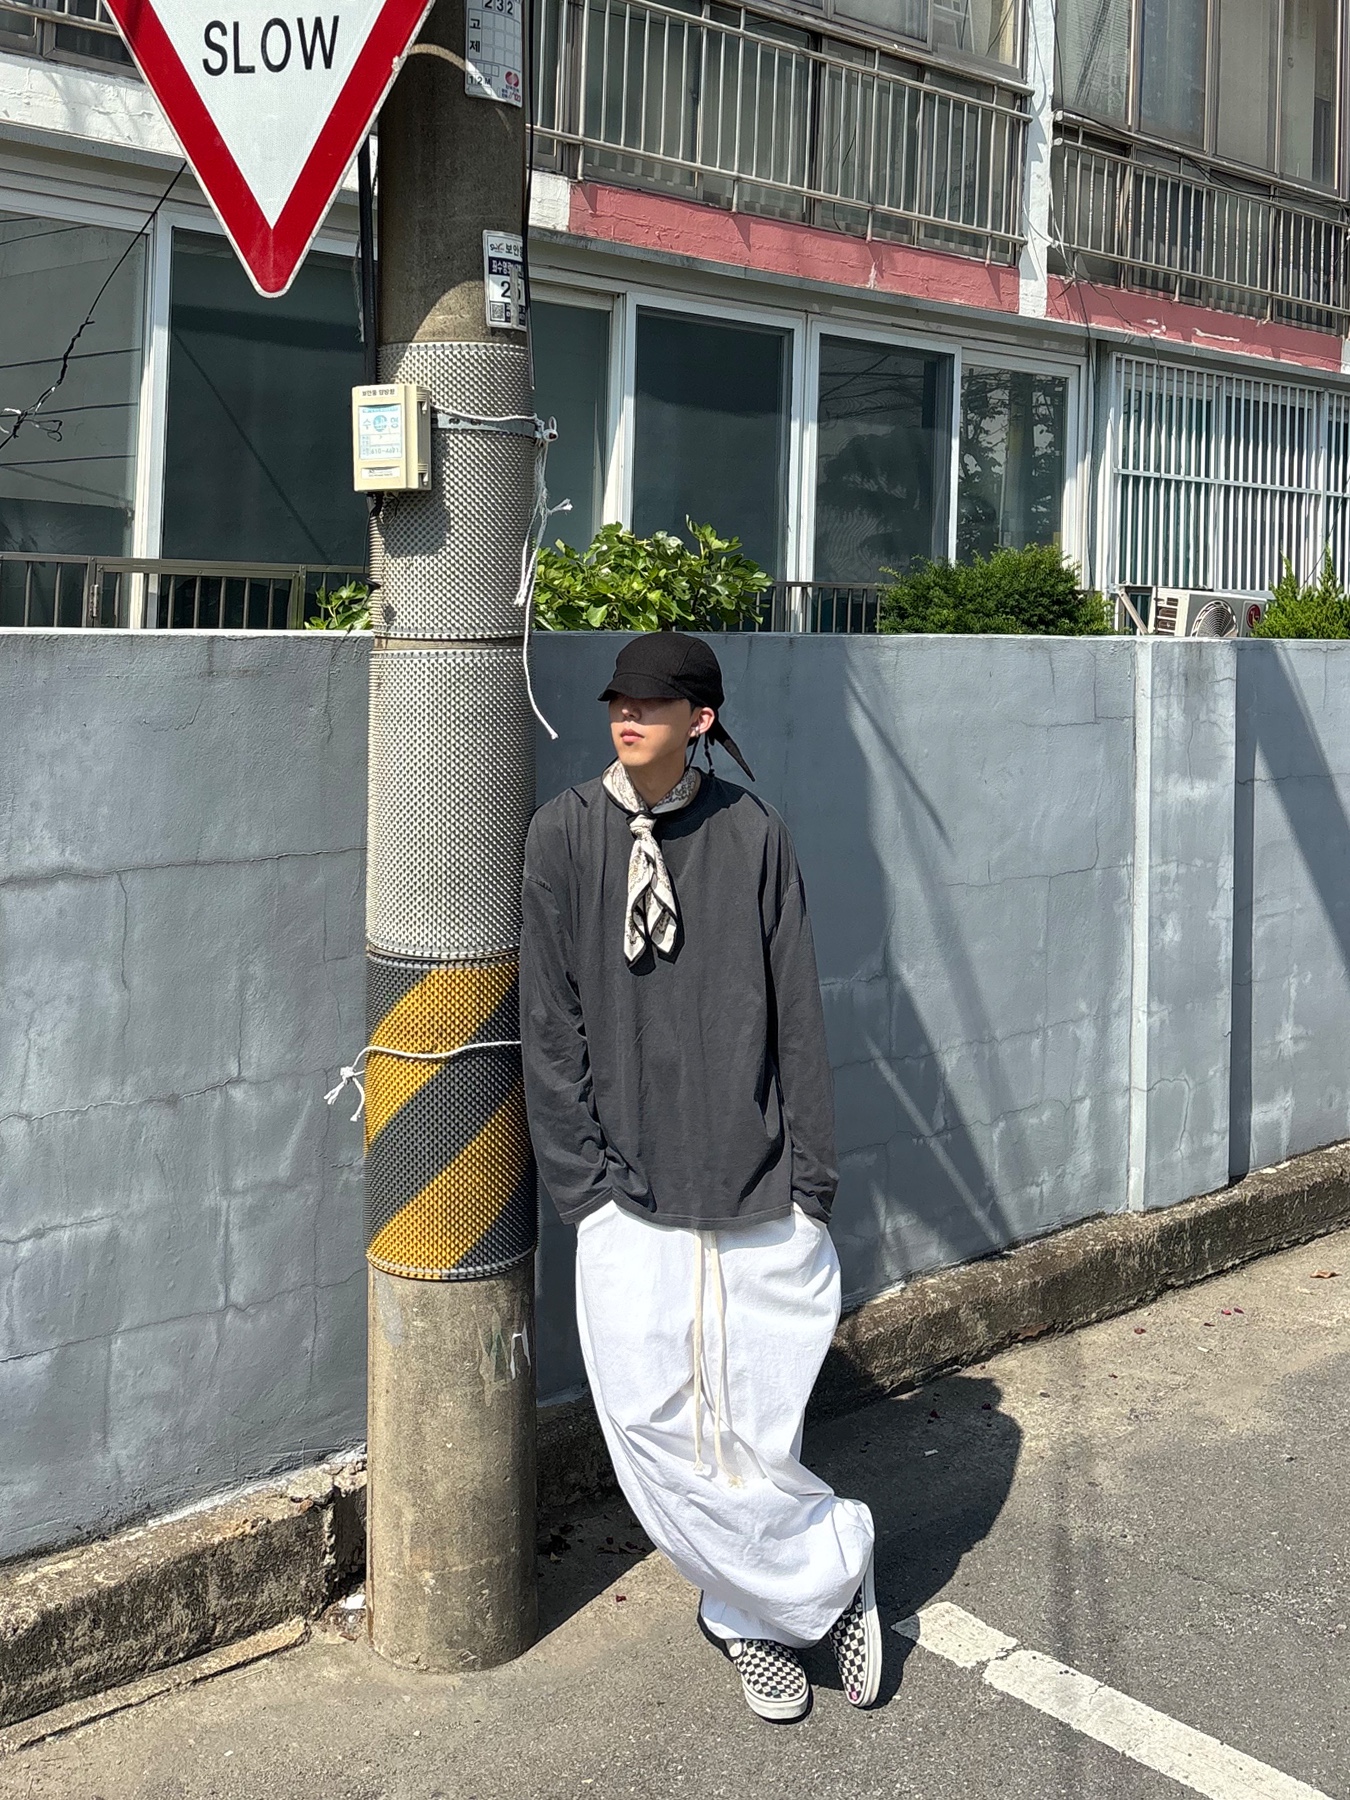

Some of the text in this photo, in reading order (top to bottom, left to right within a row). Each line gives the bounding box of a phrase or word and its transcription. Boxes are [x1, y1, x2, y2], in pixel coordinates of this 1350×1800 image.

[202, 15, 340, 76] SLOW
[362, 417, 399, 430] 수 영
